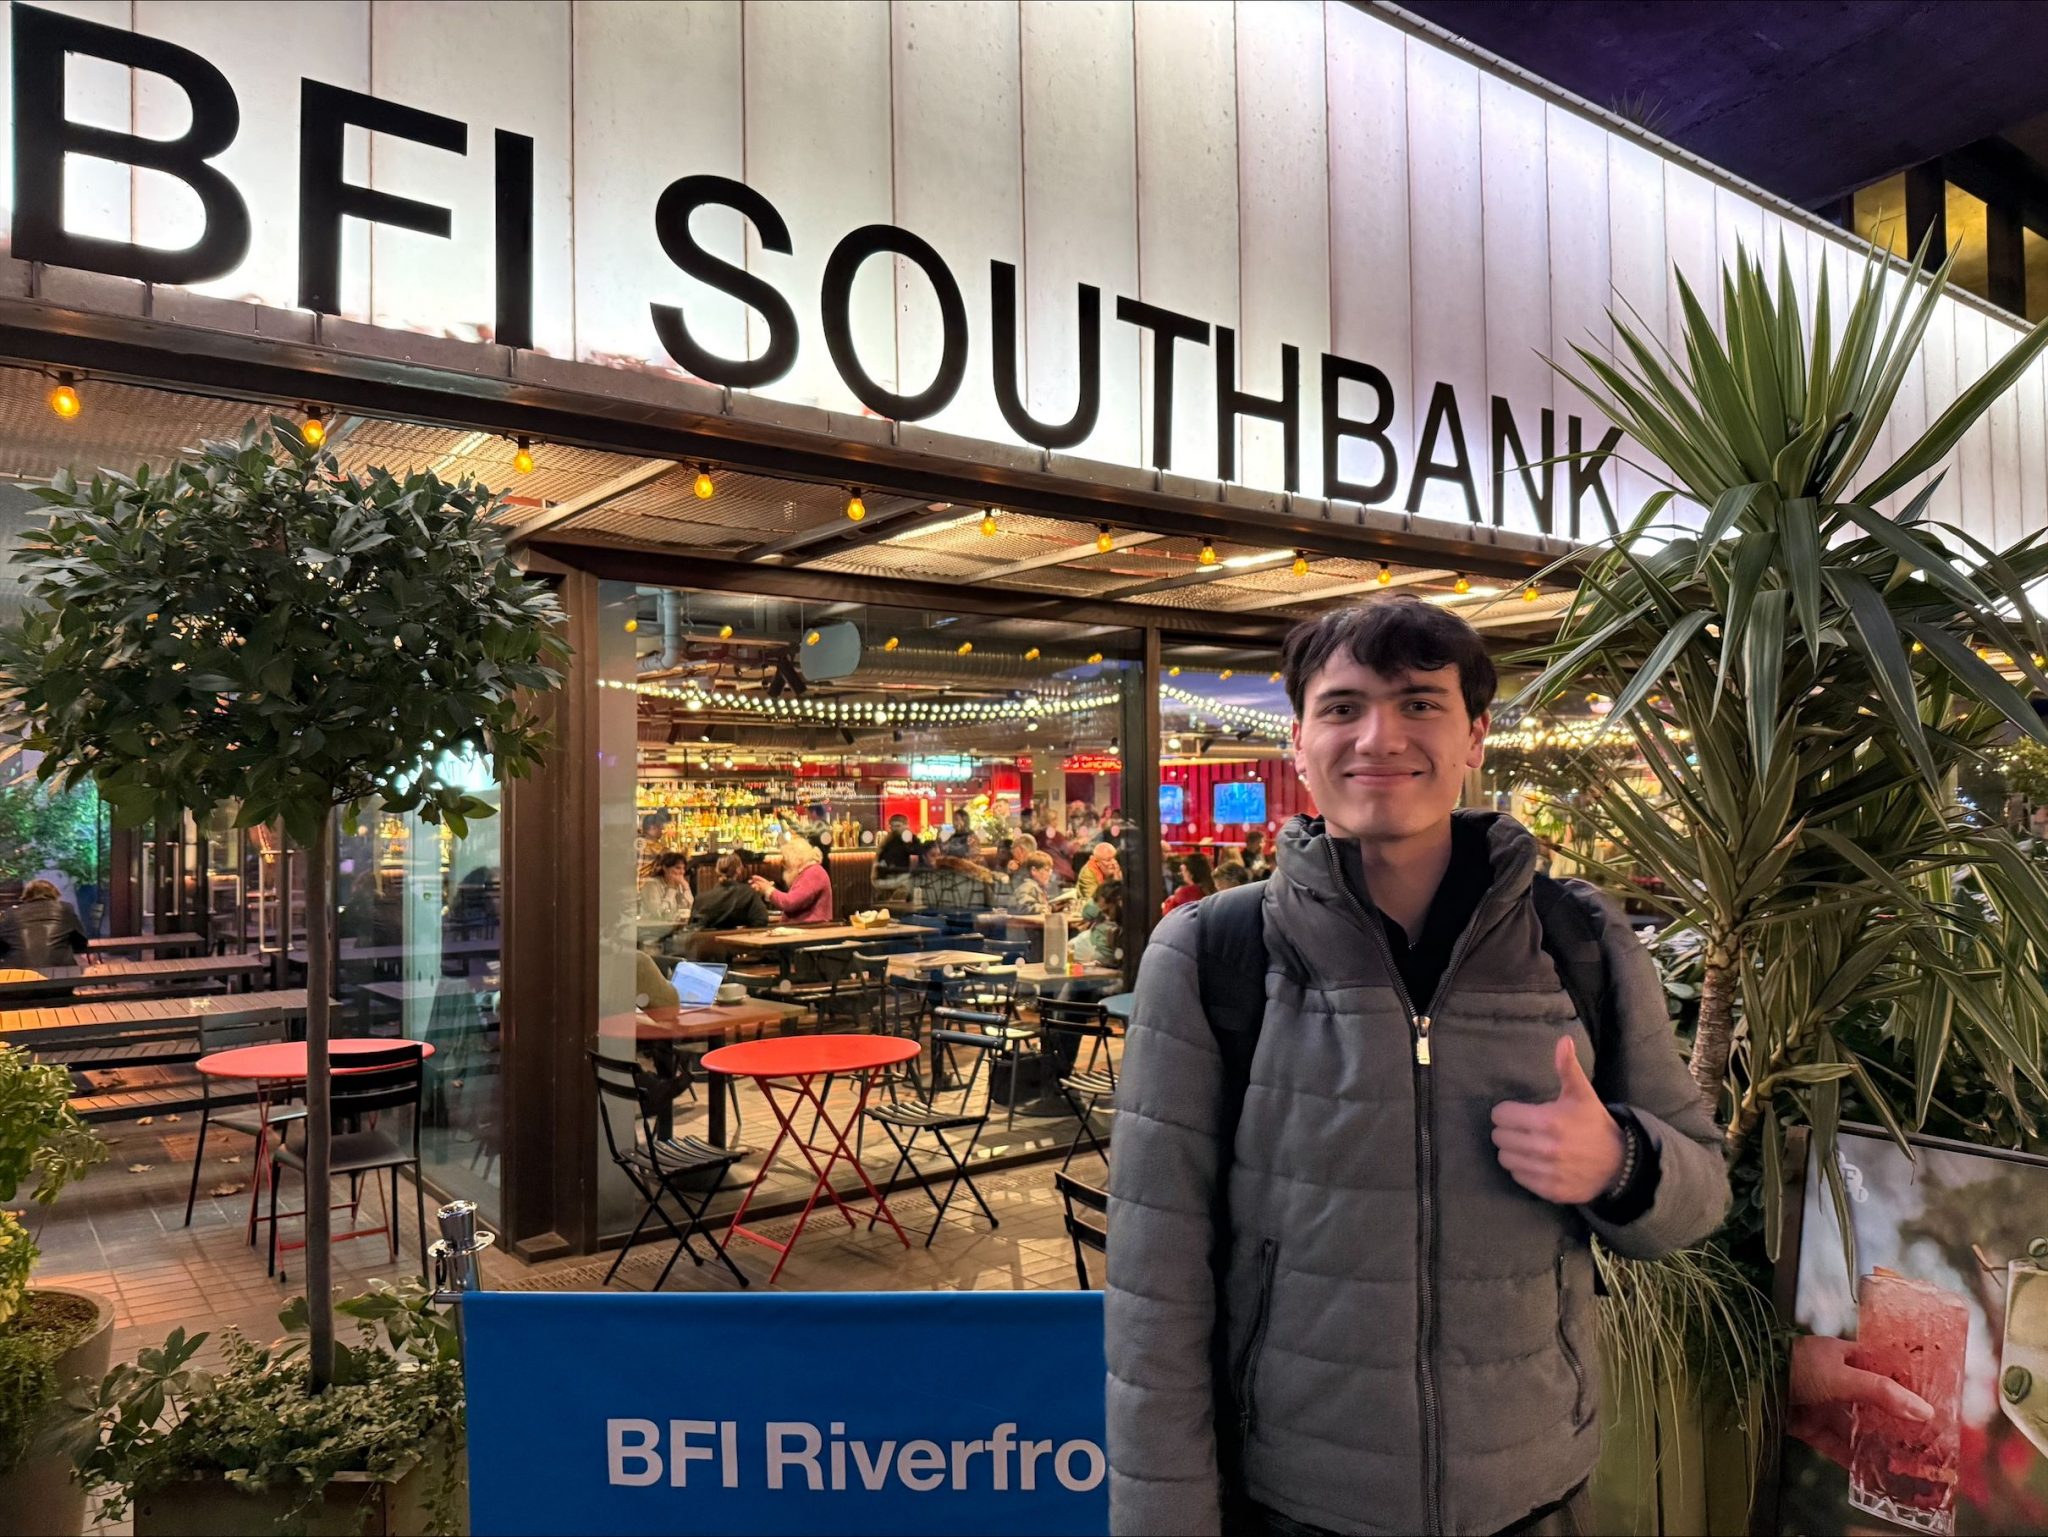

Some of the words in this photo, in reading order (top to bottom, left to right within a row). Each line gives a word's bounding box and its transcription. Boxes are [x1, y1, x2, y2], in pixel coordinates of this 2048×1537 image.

[11, 2, 534, 350] BFI
[650, 174, 1624, 542] SOUTHBANK
[606, 1418, 739, 1488] BFI
[766, 1421, 1106, 1491] Riverfro
